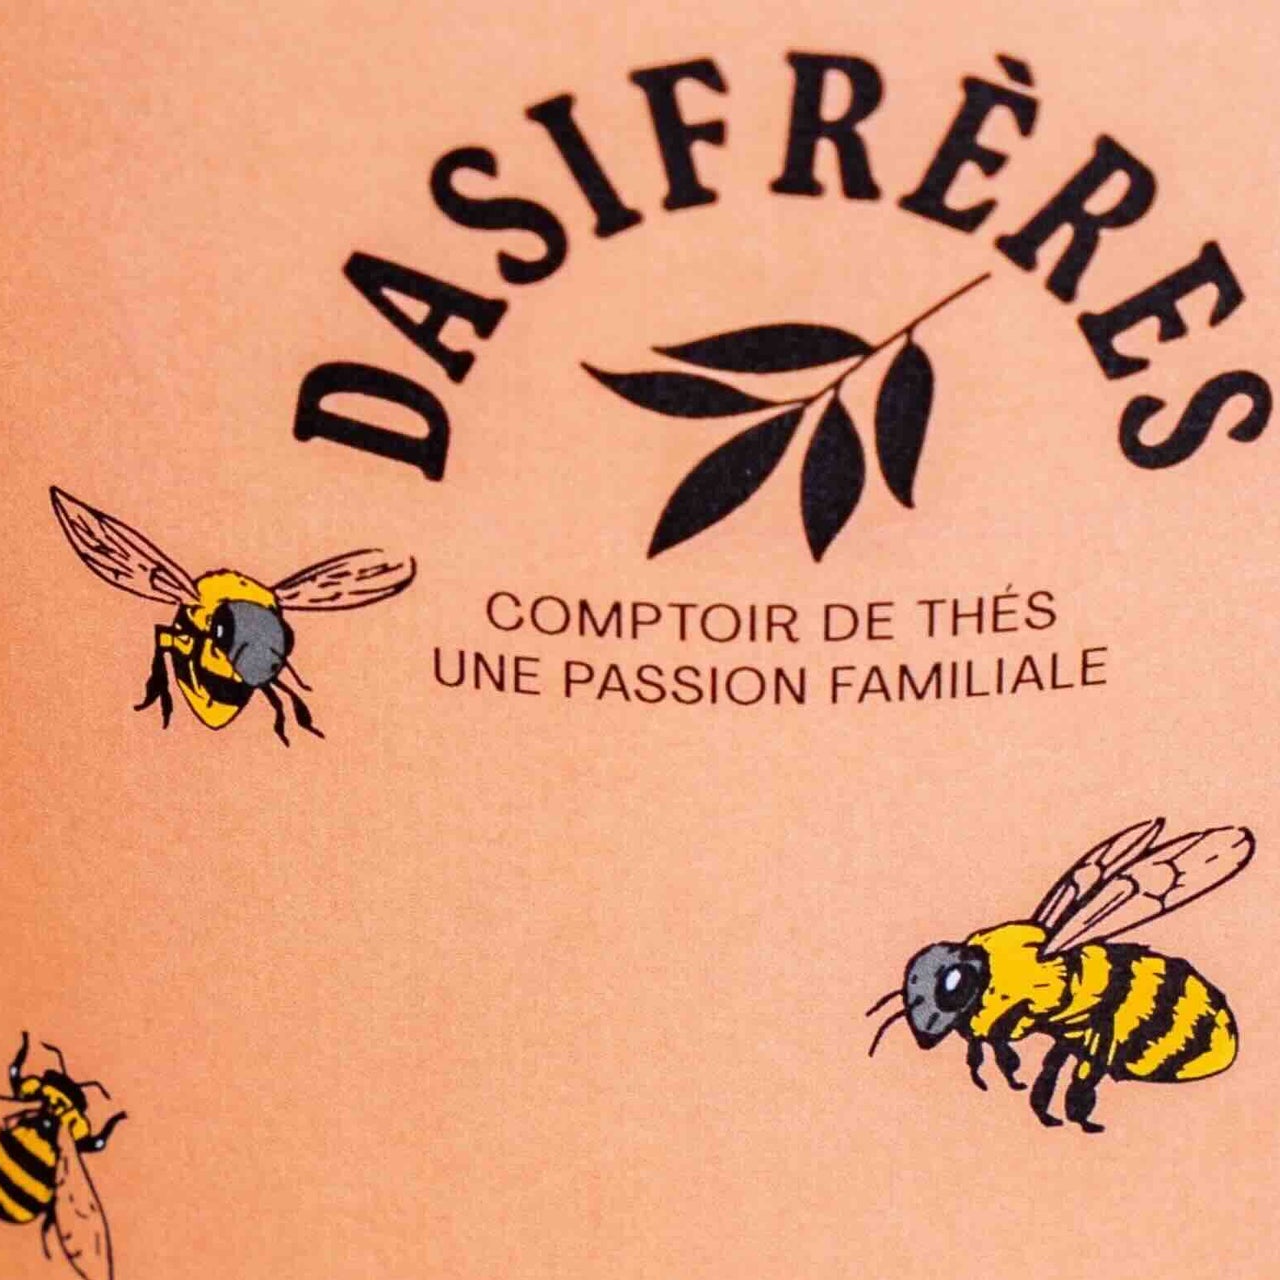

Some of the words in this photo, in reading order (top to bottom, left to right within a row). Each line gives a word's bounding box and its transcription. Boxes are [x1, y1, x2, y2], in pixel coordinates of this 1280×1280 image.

[294, 51, 1273, 481] DASIFRÈRES
[486, 591, 800, 643] COMPTOIR
[823, 601, 894, 642] DE
[917, 583, 1057, 639] THÉS
[433, 647, 540, 695] UNE
[564, 660, 806, 706] PASSION
[831, 646, 1108, 704] FAMILIALE
